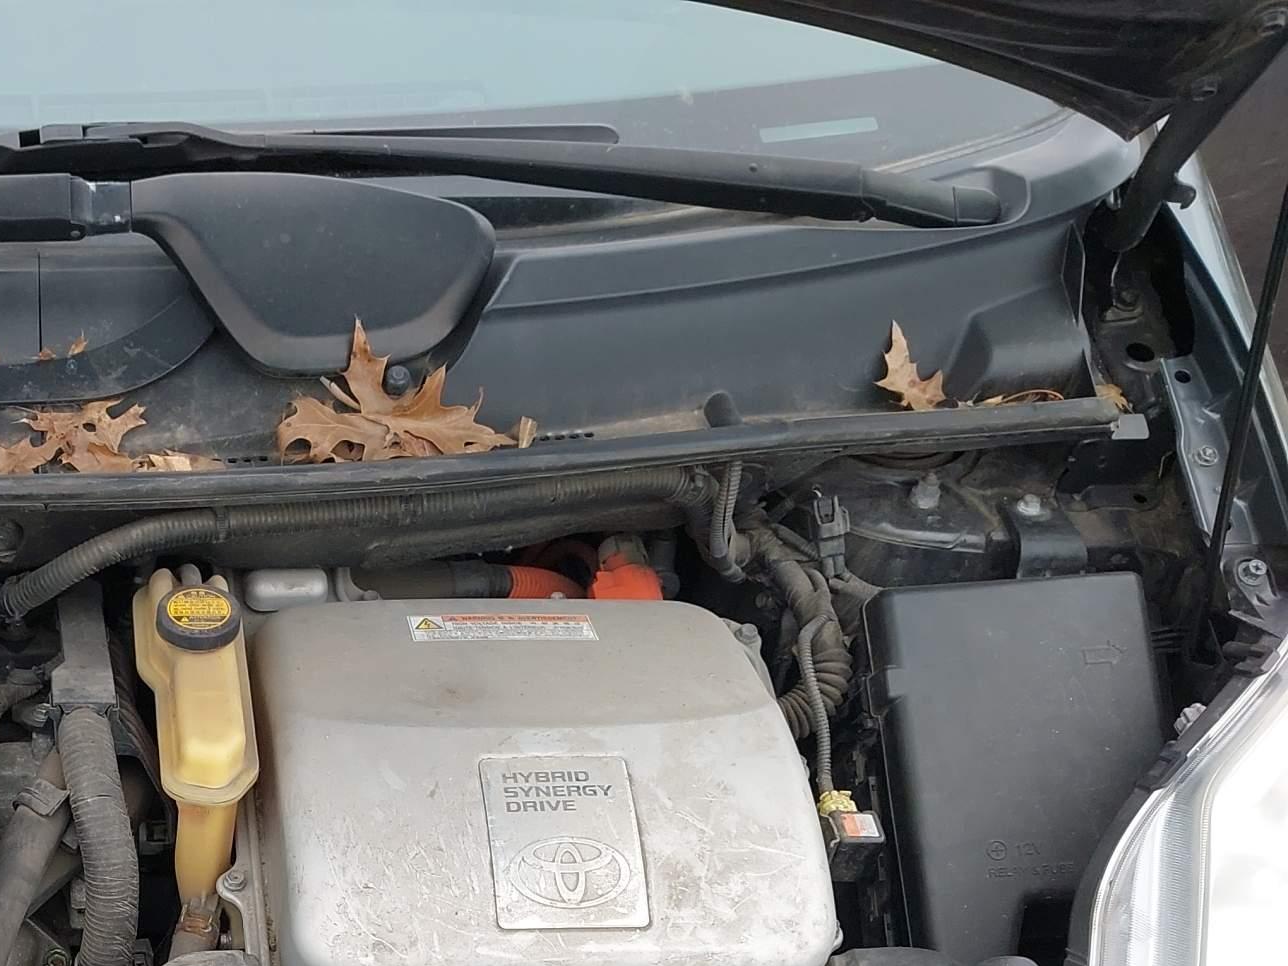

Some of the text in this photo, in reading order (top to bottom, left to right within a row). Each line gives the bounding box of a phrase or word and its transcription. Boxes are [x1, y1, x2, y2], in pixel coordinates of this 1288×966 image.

[502, 771, 590, 783] HYBRID
[504, 785, 612, 798] SYNERGY
[506, 800, 577, 813] DRIVE
